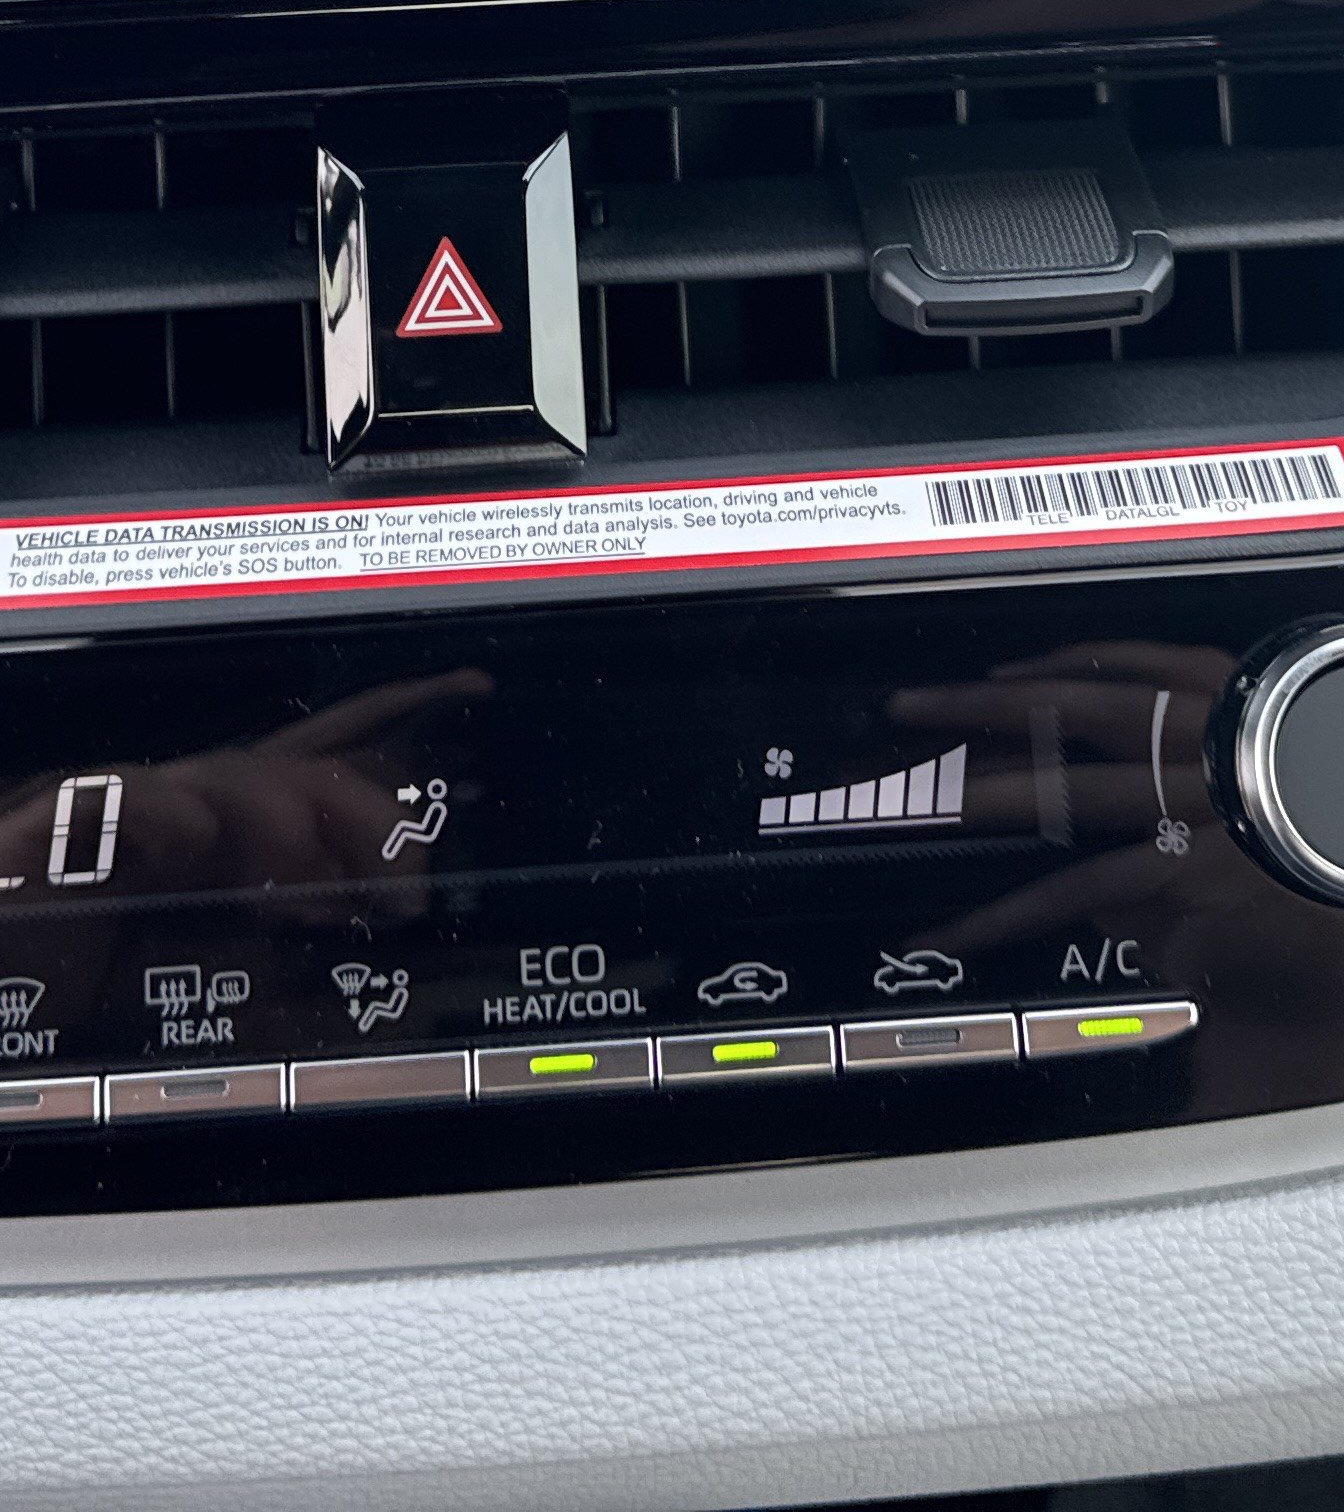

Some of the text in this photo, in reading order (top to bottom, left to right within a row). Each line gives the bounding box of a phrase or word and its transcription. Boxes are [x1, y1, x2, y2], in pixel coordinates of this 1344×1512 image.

[16, 482, 878, 549] VEHICLE DATA TRANSMISSION IS ON! Your vehicle wirelessly transmits location, driving and vehicle
[1026, 500, 1248, 527] TELE DATALGL TOY
[10, 550, 63, 568] health
[68, 548, 106, 565] data
[113, 547, 130, 563] to
[136, 543, 190, 562] deliver
[196, 543, 236, 561] your
[239, 537, 310, 557] services
[316, 534, 347, 551] and
[354, 533, 374, 548] for
[381, 526, 443, 547] internal
[448, 522, 521, 542] research
[527, 520, 557, 537] and
[563, 518, 600, 535] data
[605, 513, 679, 535] analysis.
[683, 511, 716, 528] See
[9, 536, 647, 588] To disable, press vehicle's SOS button. TO BE REMOVED BY OWNER ONLY
[518, 943, 607, 986] ECO
[1060, 938, 1141, 983] A/C
[482, 986, 646, 1026] HEAT/COOL
[161, 1016, 235, 1047] REAR
